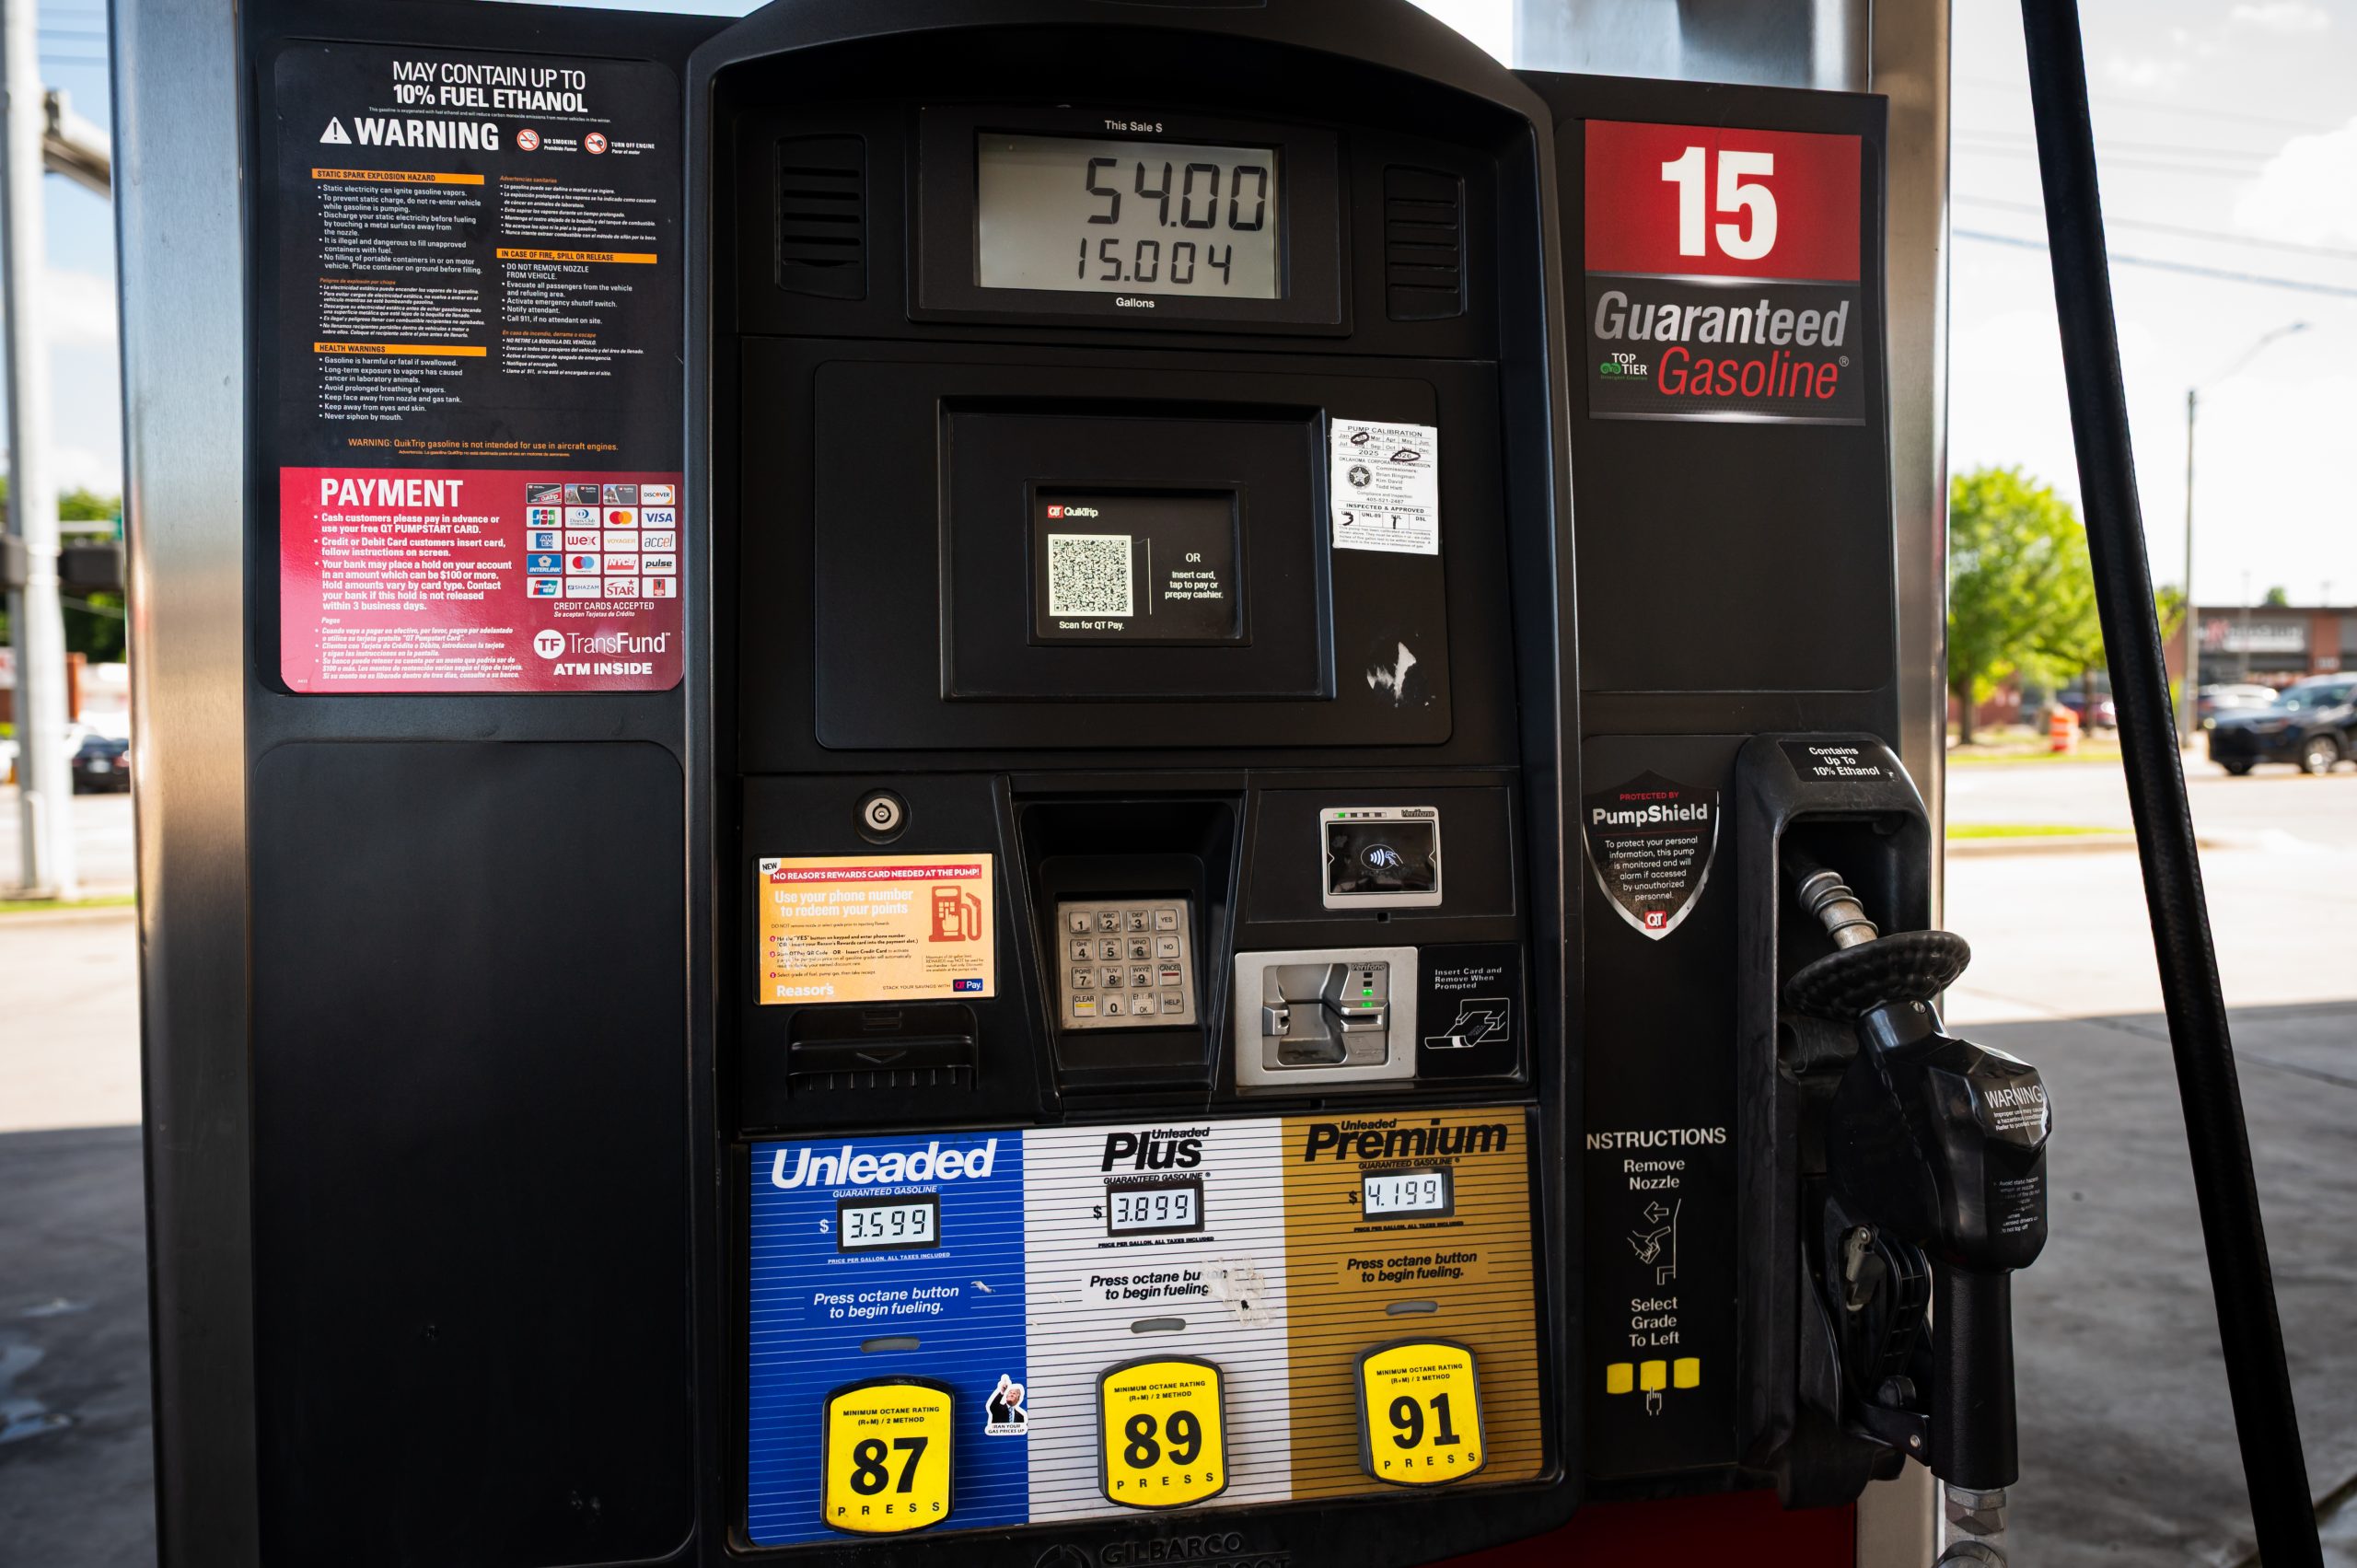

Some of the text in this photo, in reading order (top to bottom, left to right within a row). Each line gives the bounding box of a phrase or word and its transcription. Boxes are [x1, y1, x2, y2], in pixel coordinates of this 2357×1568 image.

[393, 61, 586, 90] MAY CONTAIN UP TO
[394, 84, 587, 112] 10% FUEL ETHANOL
[1105, 121, 1127, 130] This
[1130, 122, 1153, 132] Sale
[354, 118, 498, 150] WARNING
[318, 170, 341, 180] STATIC
[367, 171, 407, 180] EXPLOSION
[408, 172, 436, 181] HAZARD
[1086, 157, 1269, 233] 54.00
[1662, 146, 1777, 260] 15
[1078, 238, 1232, 285] 15.004
[1116, 297, 1155, 308] Gallons
[1596, 291, 1849, 347] Guaranteed
[319, 344, 345, 353] HEALTH
[1611, 354, 1636, 364] TOP
[1621, 364, 1647, 375] TIER
[1372, 428, 1422, 436] CALIBRATION
[321, 479, 463, 506] PAYMENT
[646, 513, 672, 522] VISA
[1049, 507, 1062, 517] QT
[1064, 507, 1098, 517] QuikTrip
[645, 559, 672, 568] pulse
[1186, 553, 1201, 562] OR
[1196, 571, 1215, 580] card,
[607, 587, 634, 596] STAR
[1169, 581, 1183, 590] tap
[1194, 582, 1209, 590] pay
[1193, 590, 1223, 598] cashier.
[1081, 621, 1093, 629] for
[1095, 621, 1106, 630] QT
[1108, 621, 1124, 631] Pay.
[553, 663, 652, 675] ATM INSIDE
[1824, 757, 1840, 766] Up
[1813, 766, 1880, 775] 10% Ethanol
[1620, 792, 1666, 800] PROTECTED
[1593, 804, 1707, 826] PumpShield
[1617, 840, 1644, 849] protect
[1666, 836, 1698, 846] personal
[1609, 850, 1655, 858] information,
[1673, 849, 1694, 857] pump
[1622, 860, 1661, 869] monitored
[1620, 872, 1642, 880] alarm
[1651, 869, 1686, 878] accessed
[1634, 880, 1684, 889] unauthorized
[775, 889, 913, 904] Use your phone number
[1635, 891, 1673, 902] personnel.
[781, 902, 908, 918] to redeem your points
[1647, 913, 1664, 927] QT
[1079, 948, 1086, 958] 4
[1108, 947, 1114, 958] 5
[1080, 976, 1086, 985] 7
[1985, 1085, 2042, 1109] WARNING
[1341, 1119, 1397, 1131] Unleaded
[1152, 1127, 1210, 1139] Unleaded
[1587, 1127, 1726, 1149] NSTRUCTIONS
[1305, 1120, 1508, 1162] Premium
[1101, 1132, 1202, 1172] Plus
[771, 1138, 998, 1189] Unleaded
[1624, 1159, 1685, 1172] Remove
[1630, 1175, 1679, 1190] Nozzle
[1348, 1179, 1436, 1207] $ 4.199
[1092, 1195, 1189, 1223] $ 3.899
[819, 1209, 926, 1239] $ 3.599
[814, 1286, 958, 1305] Press octane button
[830, 1301, 943, 1318] to begin fueling.
[1631, 1297, 1678, 1312] Select
[1631, 1315, 1677, 1330] Grade
[1629, 1331, 1679, 1347] To Left
[1389, 1393, 1460, 1449] 91
[1124, 1411, 1202, 1469] 89
[850, 1436, 928, 1495] 87
[838, 1502, 940, 1516] PRESS
